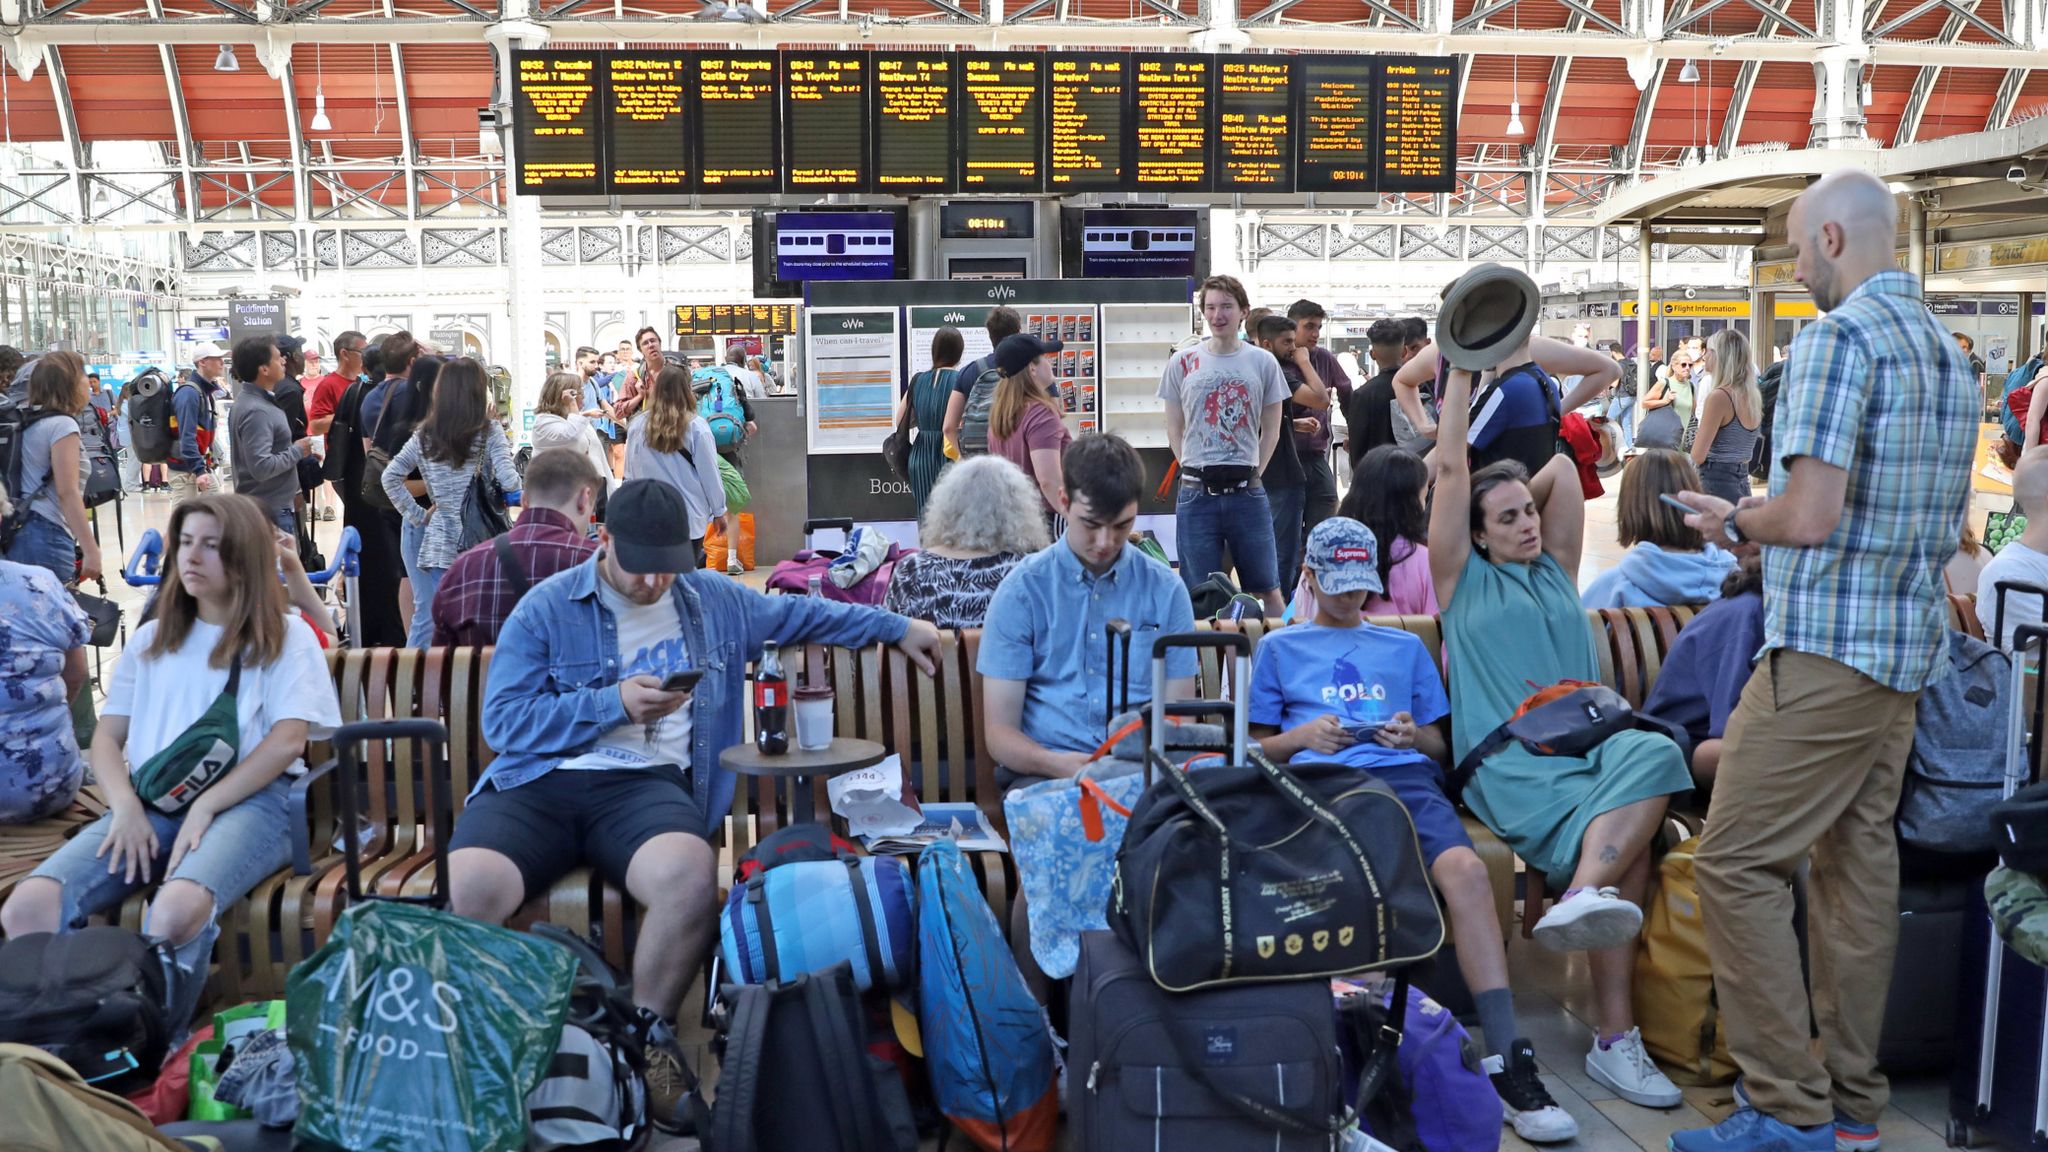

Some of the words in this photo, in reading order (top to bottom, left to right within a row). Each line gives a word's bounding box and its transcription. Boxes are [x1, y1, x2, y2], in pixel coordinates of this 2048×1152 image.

[1249, 64, 1280, 73] Platform
[1260, 125, 1287, 134] Airport
[987, 284, 1015, 299] GWR
[235, 303, 279, 315] Paddington
[1674, 304, 1694, 314] Flight
[1695, 304, 1737, 313] Information
[243, 316, 272, 326] Station
[842, 317, 864, 329] GWR
[943, 311, 965, 323] GWR
[816, 337, 838, 345] When
[859, 336, 885, 344] travel?
[869, 478, 912, 494] Book
[1336, 549, 1367, 559] Supreme
[1321, 683, 1386, 701] POLO
[170, 760, 222, 803] FILA
[1221, 886, 1232, 932] WIZARDRY
[327, 948, 462, 1033] M&S
[342, 1030, 419, 1060] FOOD
